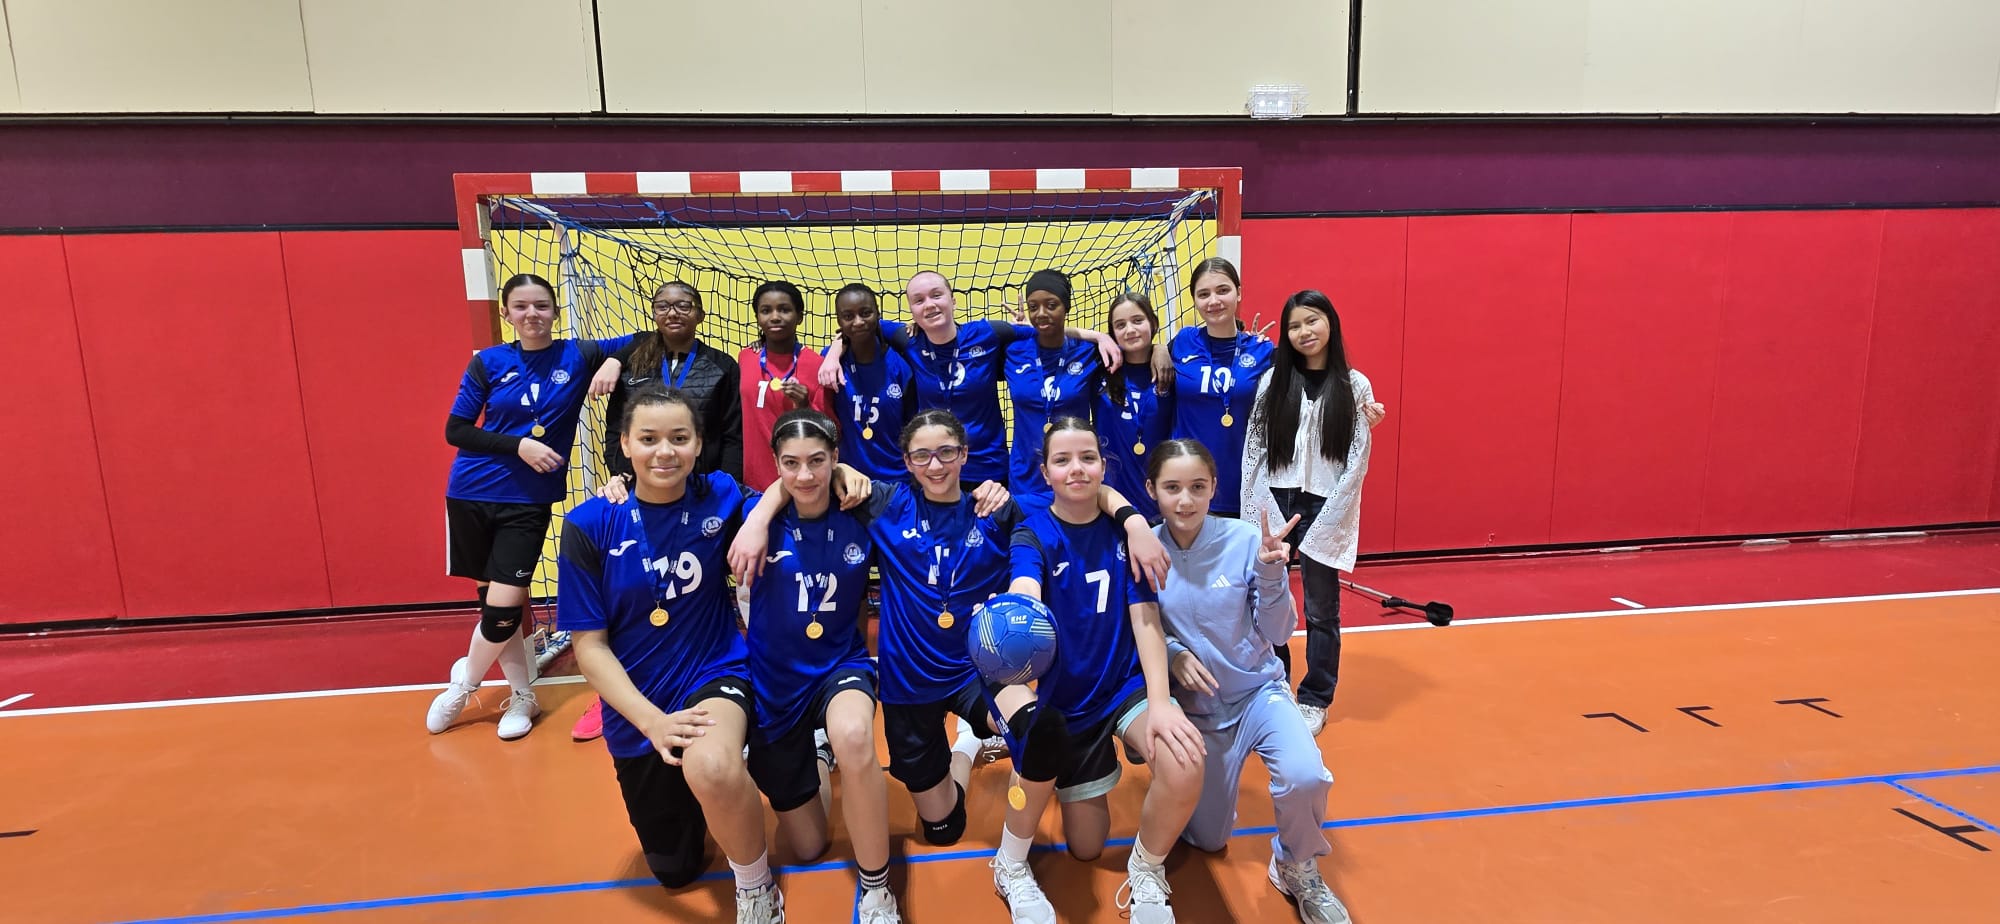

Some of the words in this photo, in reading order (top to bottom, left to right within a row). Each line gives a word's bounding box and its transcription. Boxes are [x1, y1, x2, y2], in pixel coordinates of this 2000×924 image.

[948, 361, 965, 387] 9
[1200, 365, 1232, 393] 10
[652, 551, 703, 600] 19
[928, 545, 956, 588] 1
[795, 572, 838, 612] 12
[1085, 569, 1110, 613] 7
